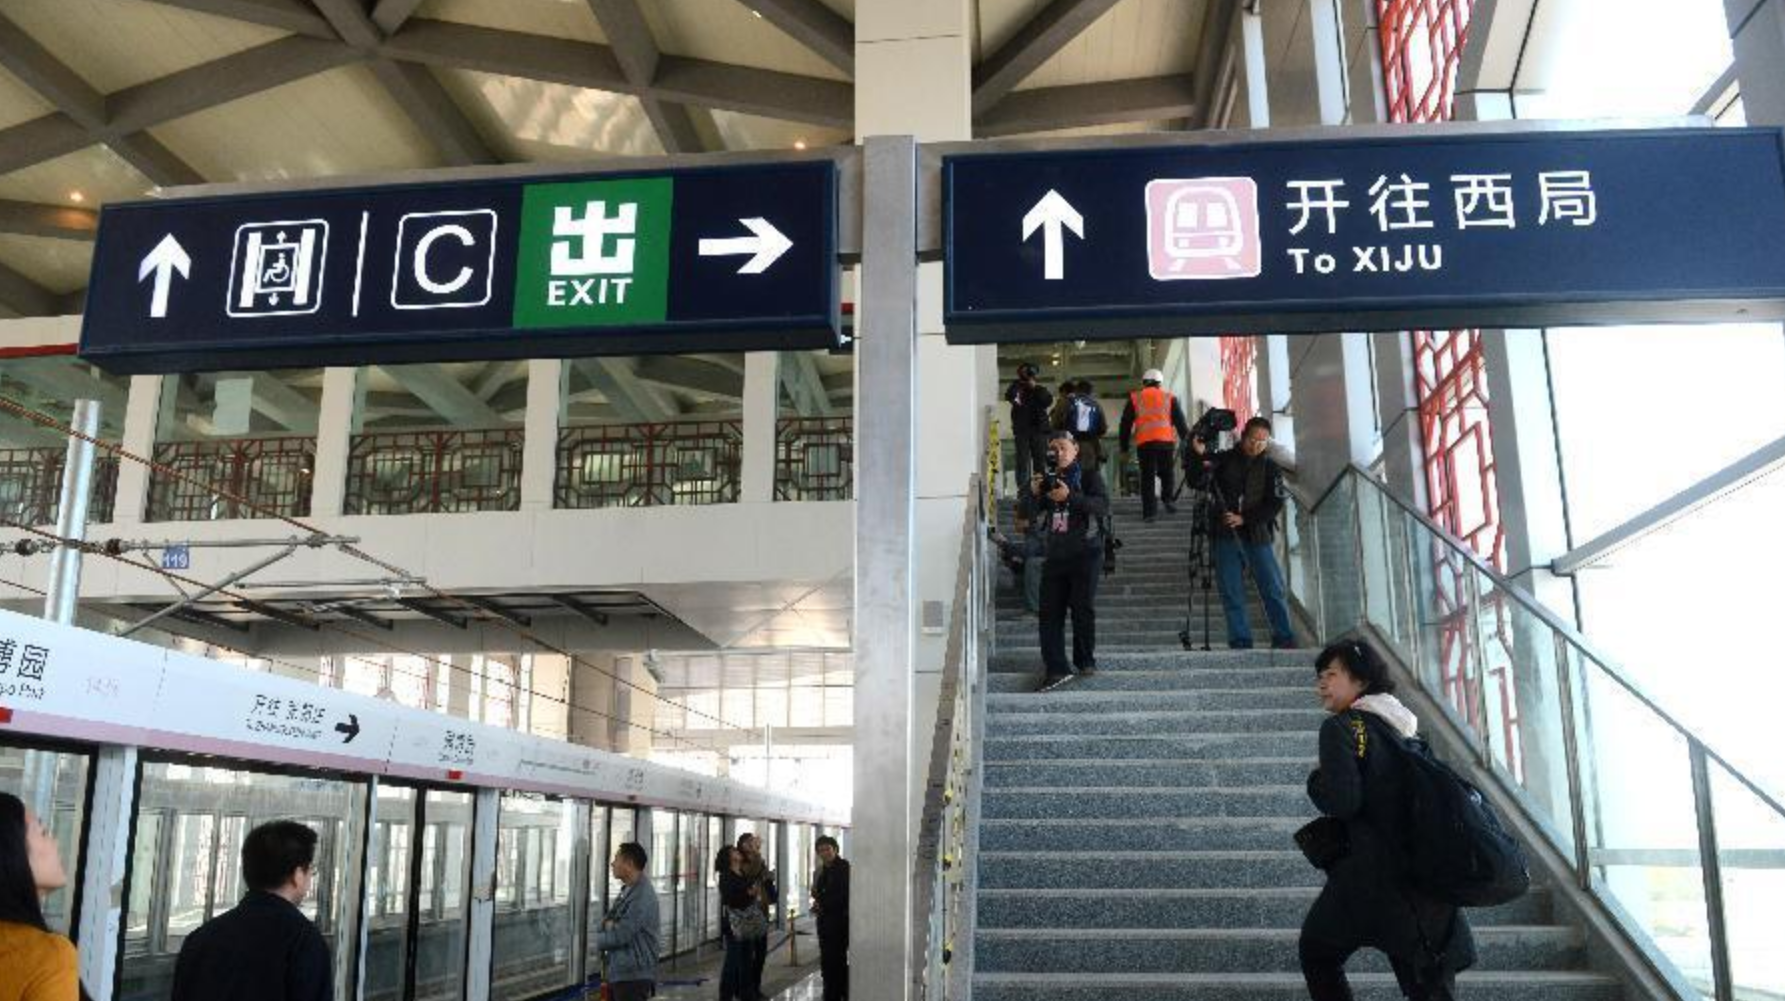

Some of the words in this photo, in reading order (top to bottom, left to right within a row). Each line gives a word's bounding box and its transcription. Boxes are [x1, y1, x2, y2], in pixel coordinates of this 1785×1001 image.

[1286, 170, 1597, 235] 开往西局
[413, 224, 476, 294] C
[550, 200, 638, 276] 出
[1287, 248, 1337, 274] To
[1352, 244, 1442, 272] XIJU
[546, 278, 633, 306] EXIT
